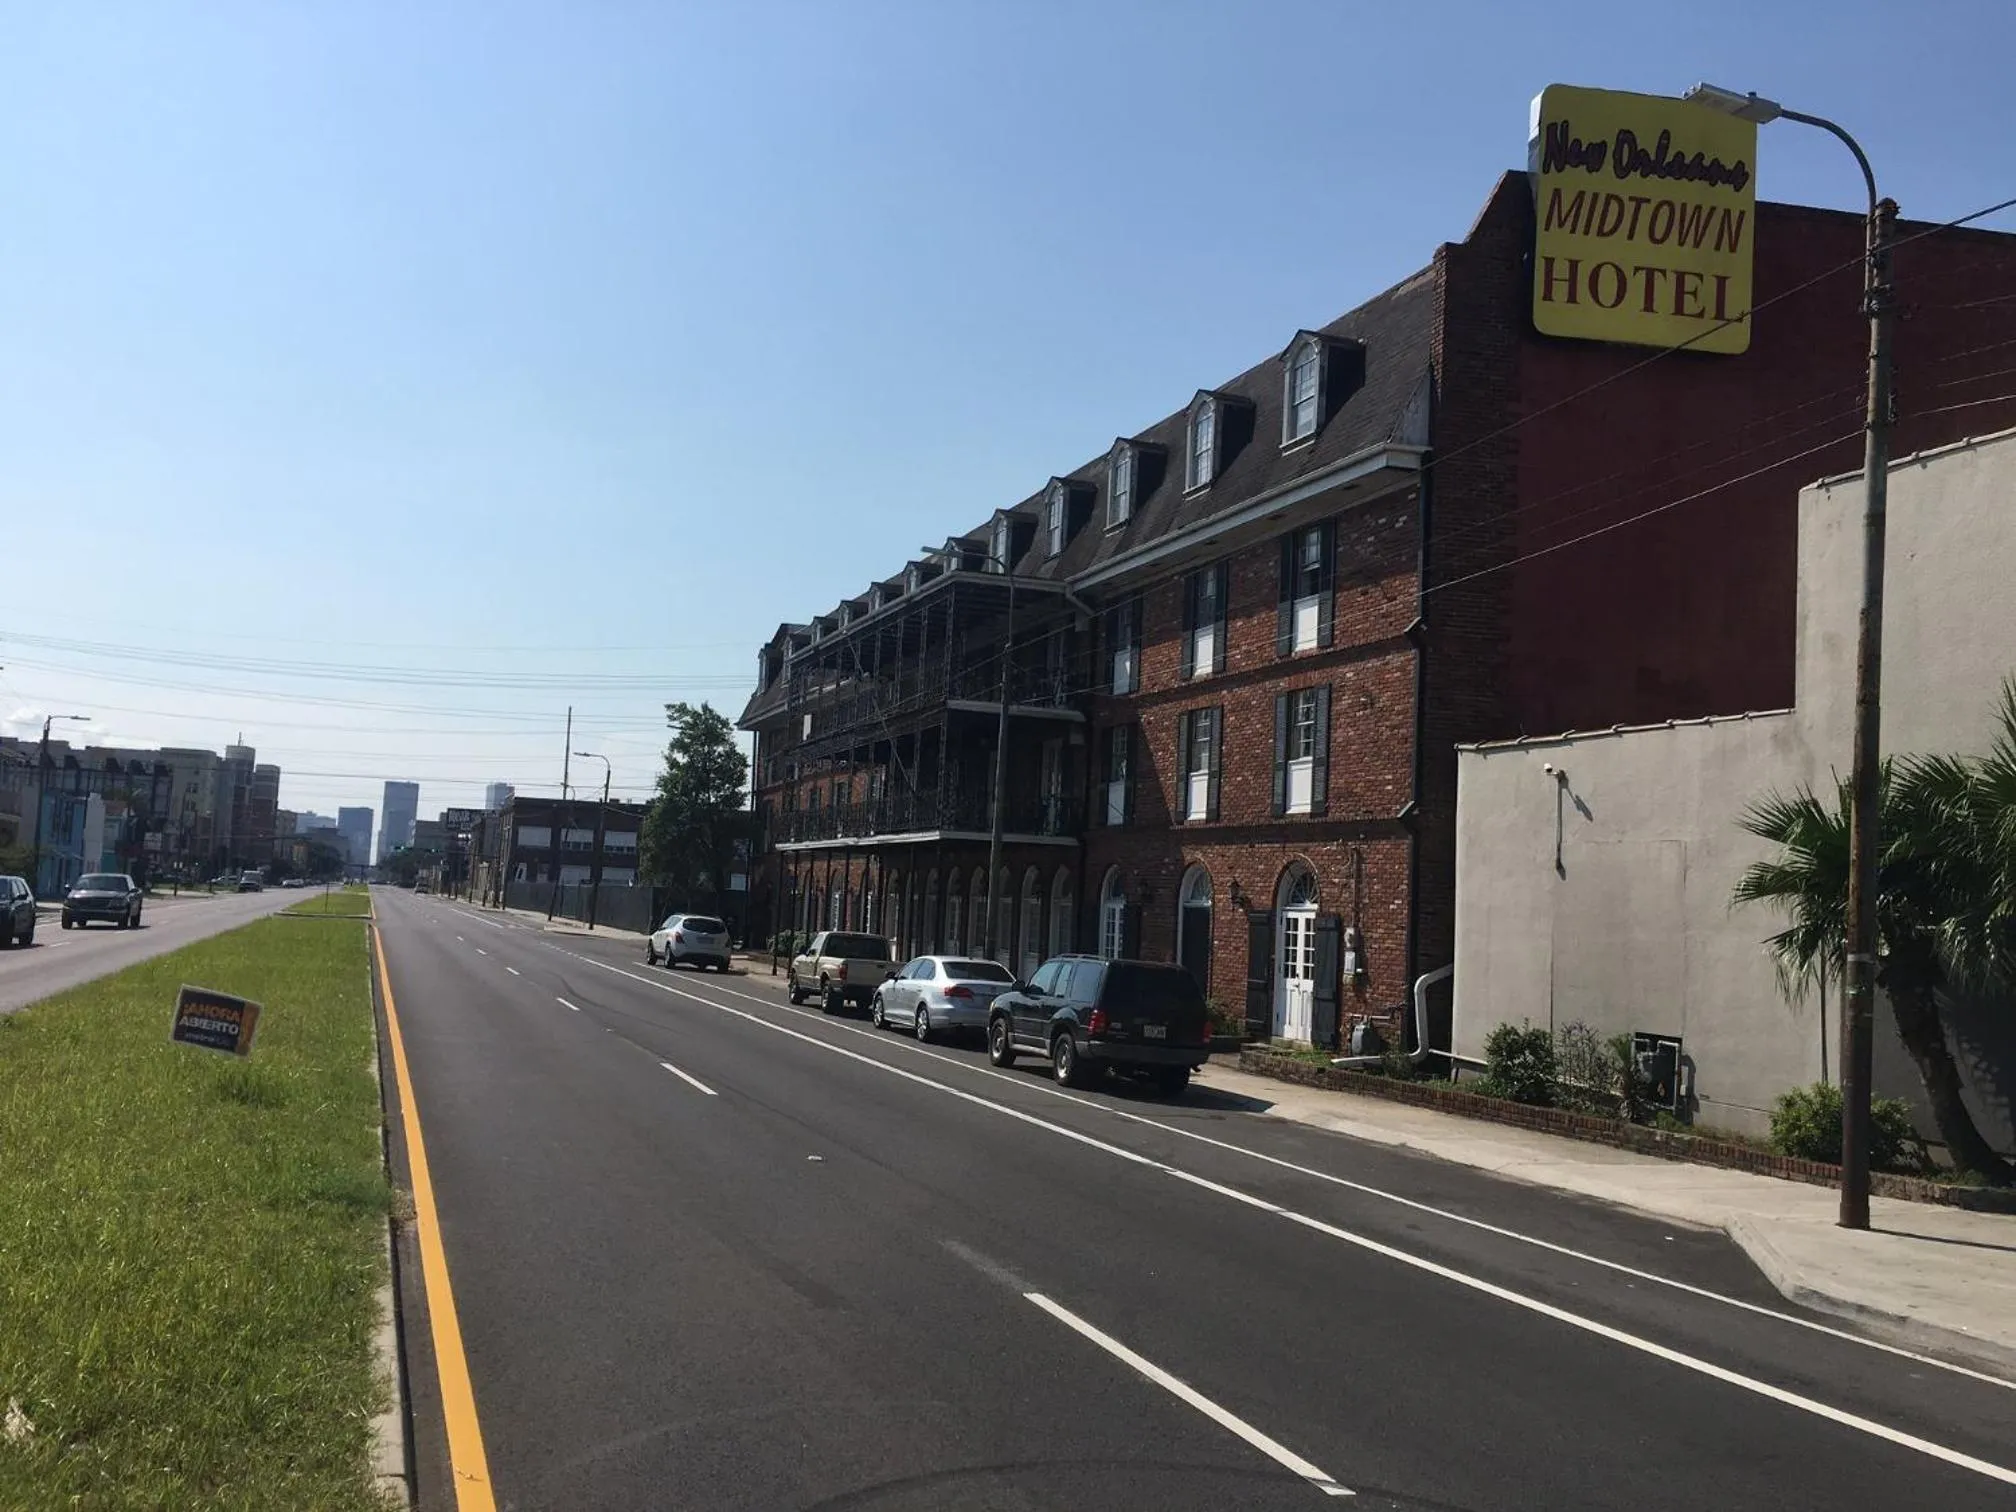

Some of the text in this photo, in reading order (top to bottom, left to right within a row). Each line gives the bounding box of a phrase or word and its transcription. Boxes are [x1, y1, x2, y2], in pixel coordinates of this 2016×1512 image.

[1543, 120, 1750, 192] New Orleans
[1544, 187, 1747, 254] MIDTOWN
[1541, 255, 1745, 324] HOTEL
[179, 1015, 239, 1035] ABIERTO
